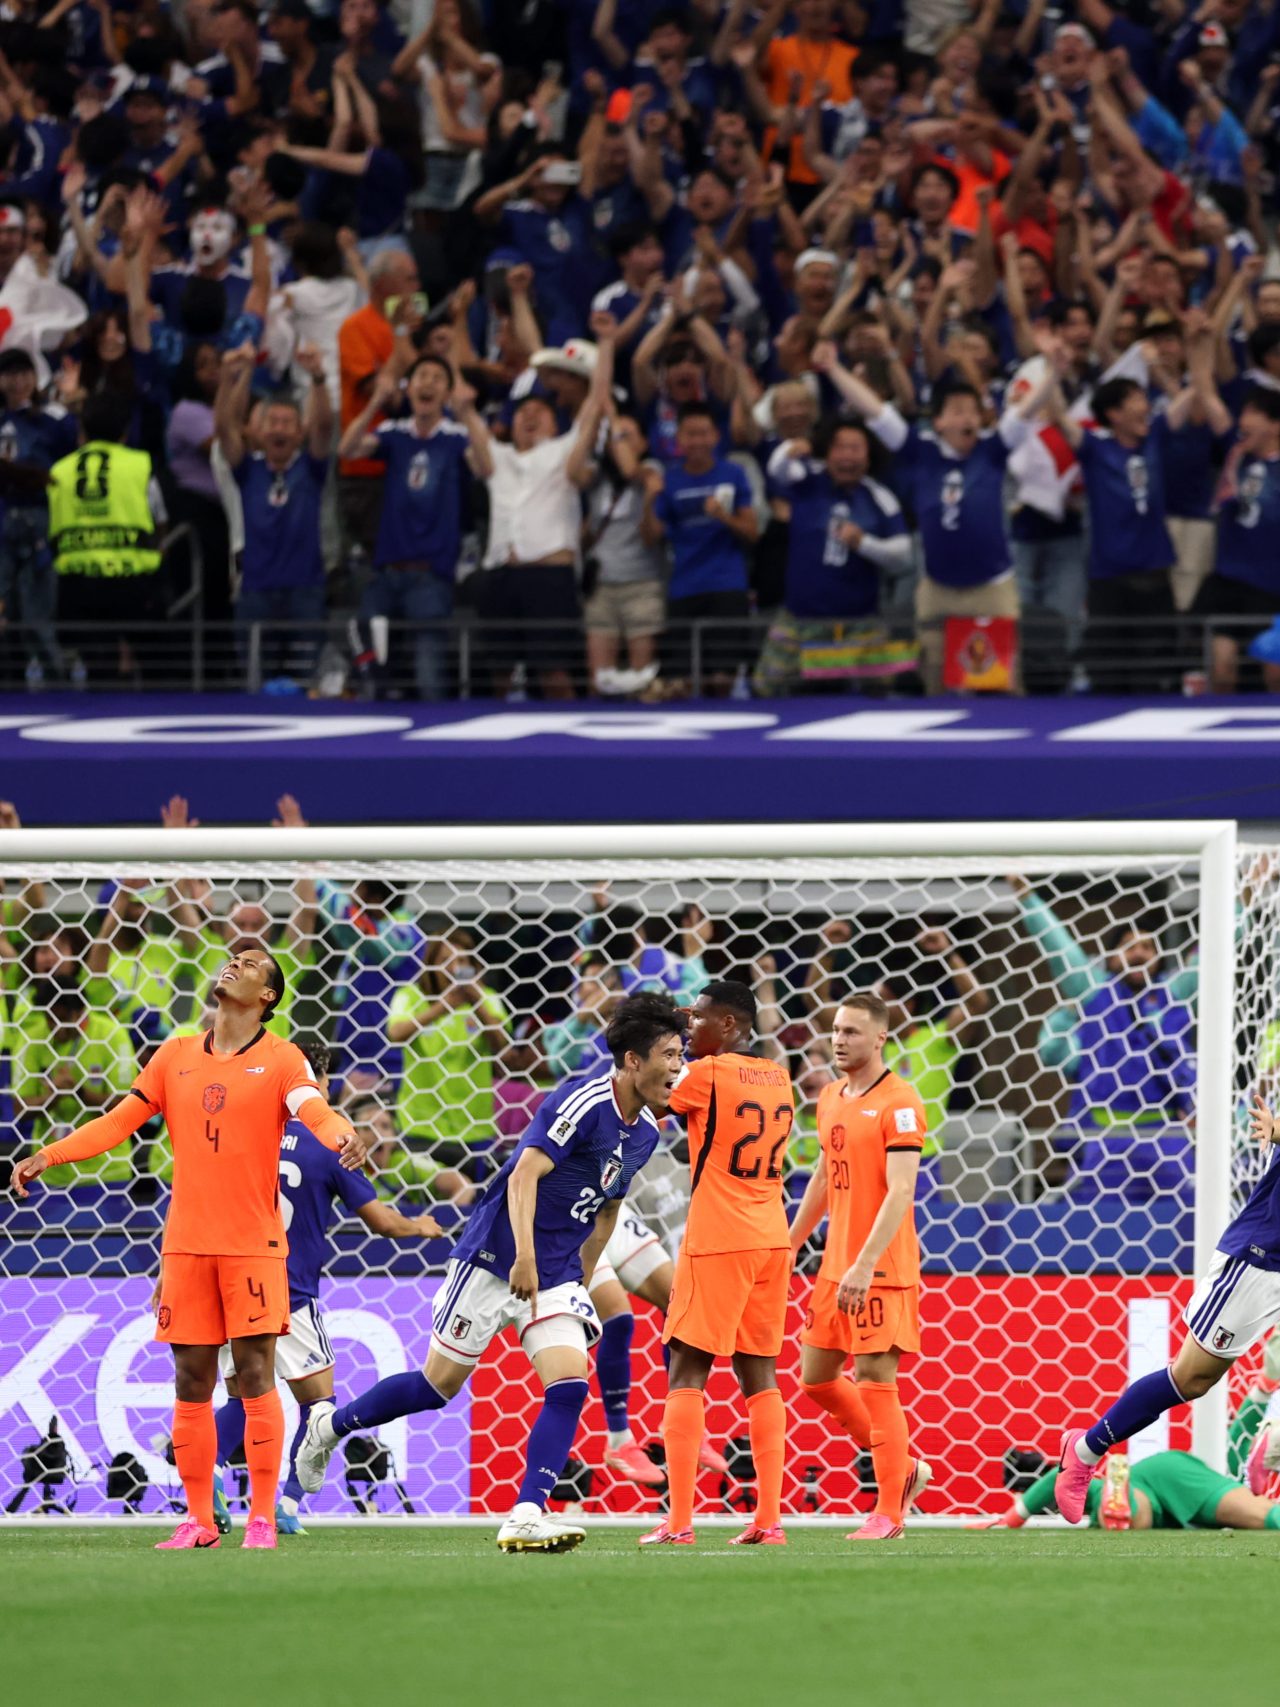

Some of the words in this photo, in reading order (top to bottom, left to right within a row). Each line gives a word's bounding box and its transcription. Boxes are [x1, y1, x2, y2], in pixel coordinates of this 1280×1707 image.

[206, 1119, 220, 1153] 4
[728, 1100, 794, 1180] 22
[831, 1159, 850, 1191] 20
[570, 1186, 606, 1225] 22
[246, 1276, 266, 1308] 4
